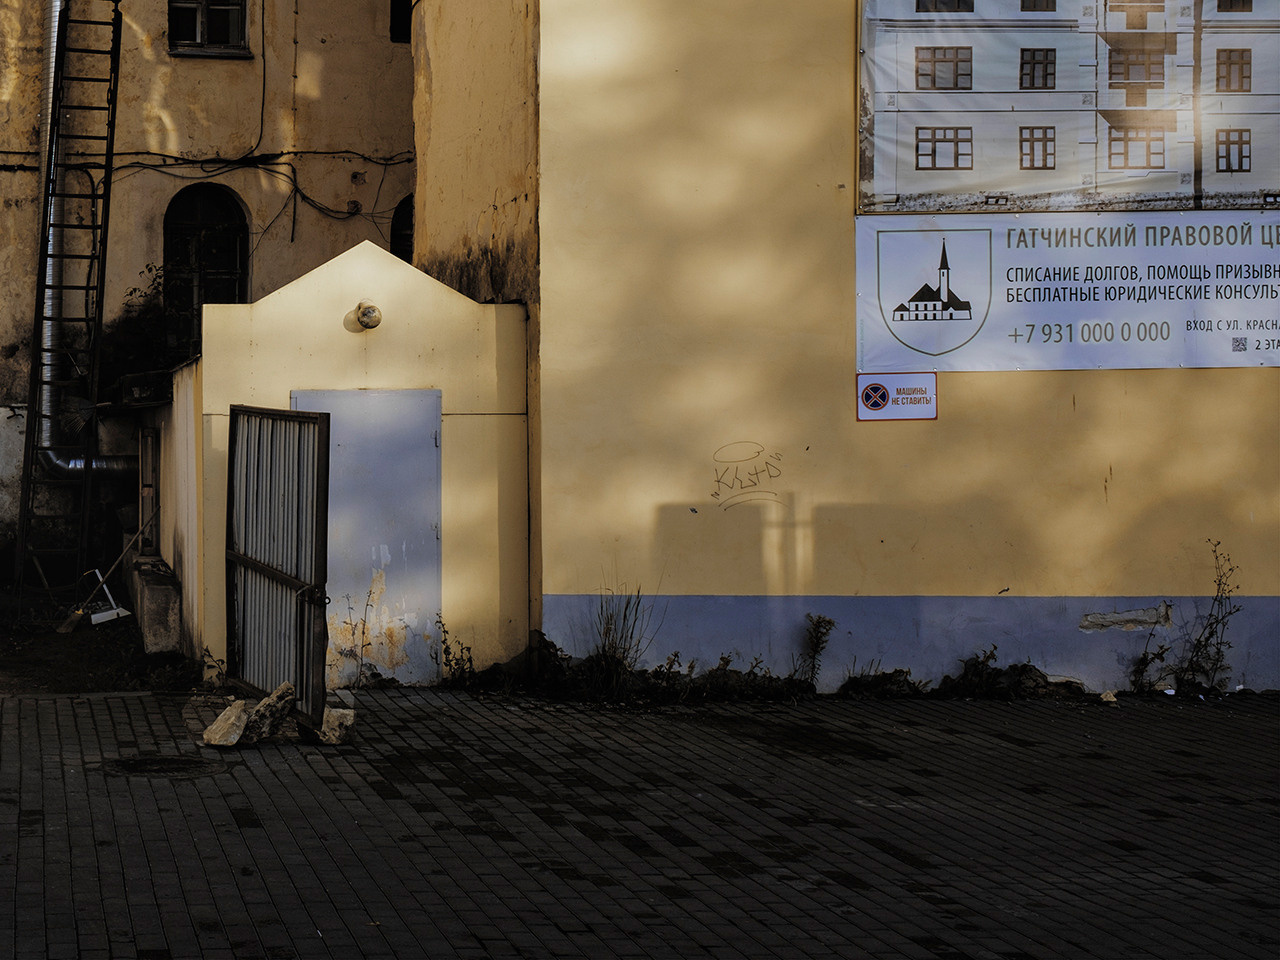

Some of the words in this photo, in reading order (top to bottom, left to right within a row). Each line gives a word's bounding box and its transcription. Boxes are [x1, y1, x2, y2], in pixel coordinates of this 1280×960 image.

[1006, 223, 1136, 249] ГАТЧИНСКИЙ
[1145, 221, 1253, 247] ПРАВОВОЙ
[1006, 266, 1080, 282] СПИСАНИЕ
[1083, 265, 1143, 284] ДОЛГОВ,
[1147, 264, 1212, 282] ПОМОЩЬ
[1215, 263, 1280, 280] ПРИЗЫВН
[1006, 286, 1101, 303] БЕСПЛАТНЫЕ
[1104, 284, 1211, 303] ЮРИДИЧЕСКИЕ
[1215, 283, 1280, 300] КОНСУЛЬ
[1007, 323, 1036, 344] +7
[1041, 323, 1073, 344] 931
[1080, 322, 1115, 343] 000
[1120, 322, 1132, 342] 0
[1137, 321, 1171, 342] 000
[1185, 319, 1213, 332] ВХОД
[1216, 319, 1224, 331] С
[1226, 319, 1243, 331] УЛ.
[1246, 319, 1280, 331] КРАСН
[1255, 339, 1262, 351] 2
[895, 387, 927, 396] МАШИНЫ
[891, 397, 900, 406] НЕ
[901, 396, 932, 406] СТАВИТЬ!
